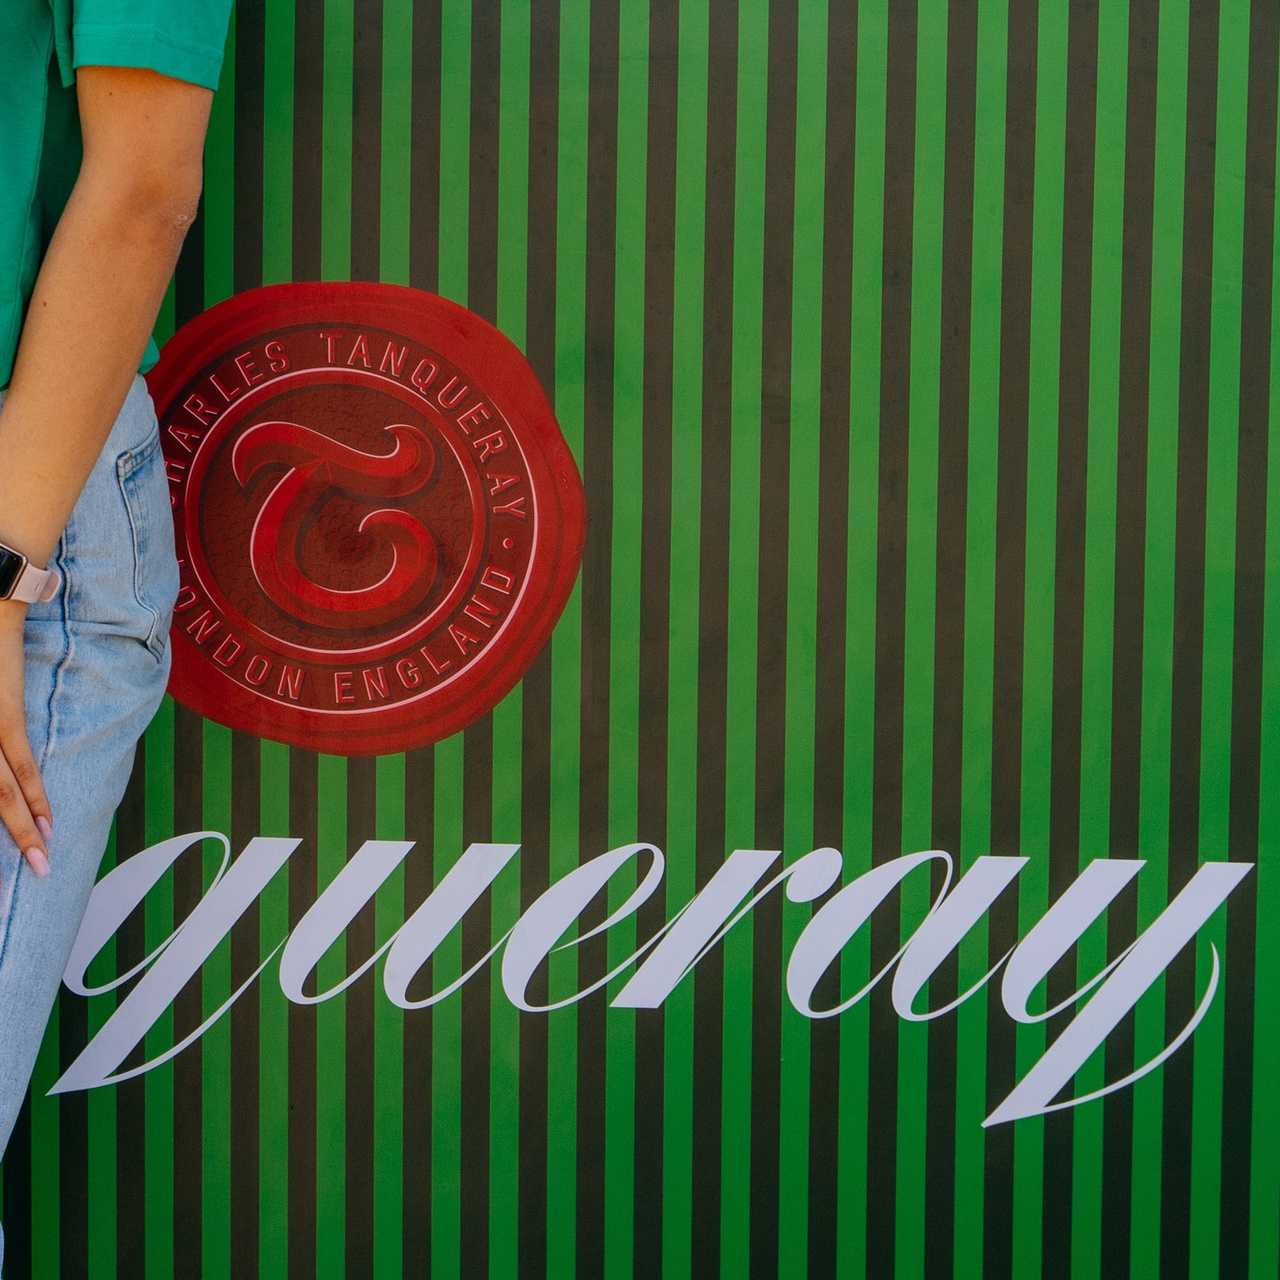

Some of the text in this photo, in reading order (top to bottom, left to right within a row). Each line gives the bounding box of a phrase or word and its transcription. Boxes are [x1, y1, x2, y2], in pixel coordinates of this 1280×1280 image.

[320, 331, 528, 520] TANQUERAY
[172, 559, 517, 705] ONDON ENGLAND
